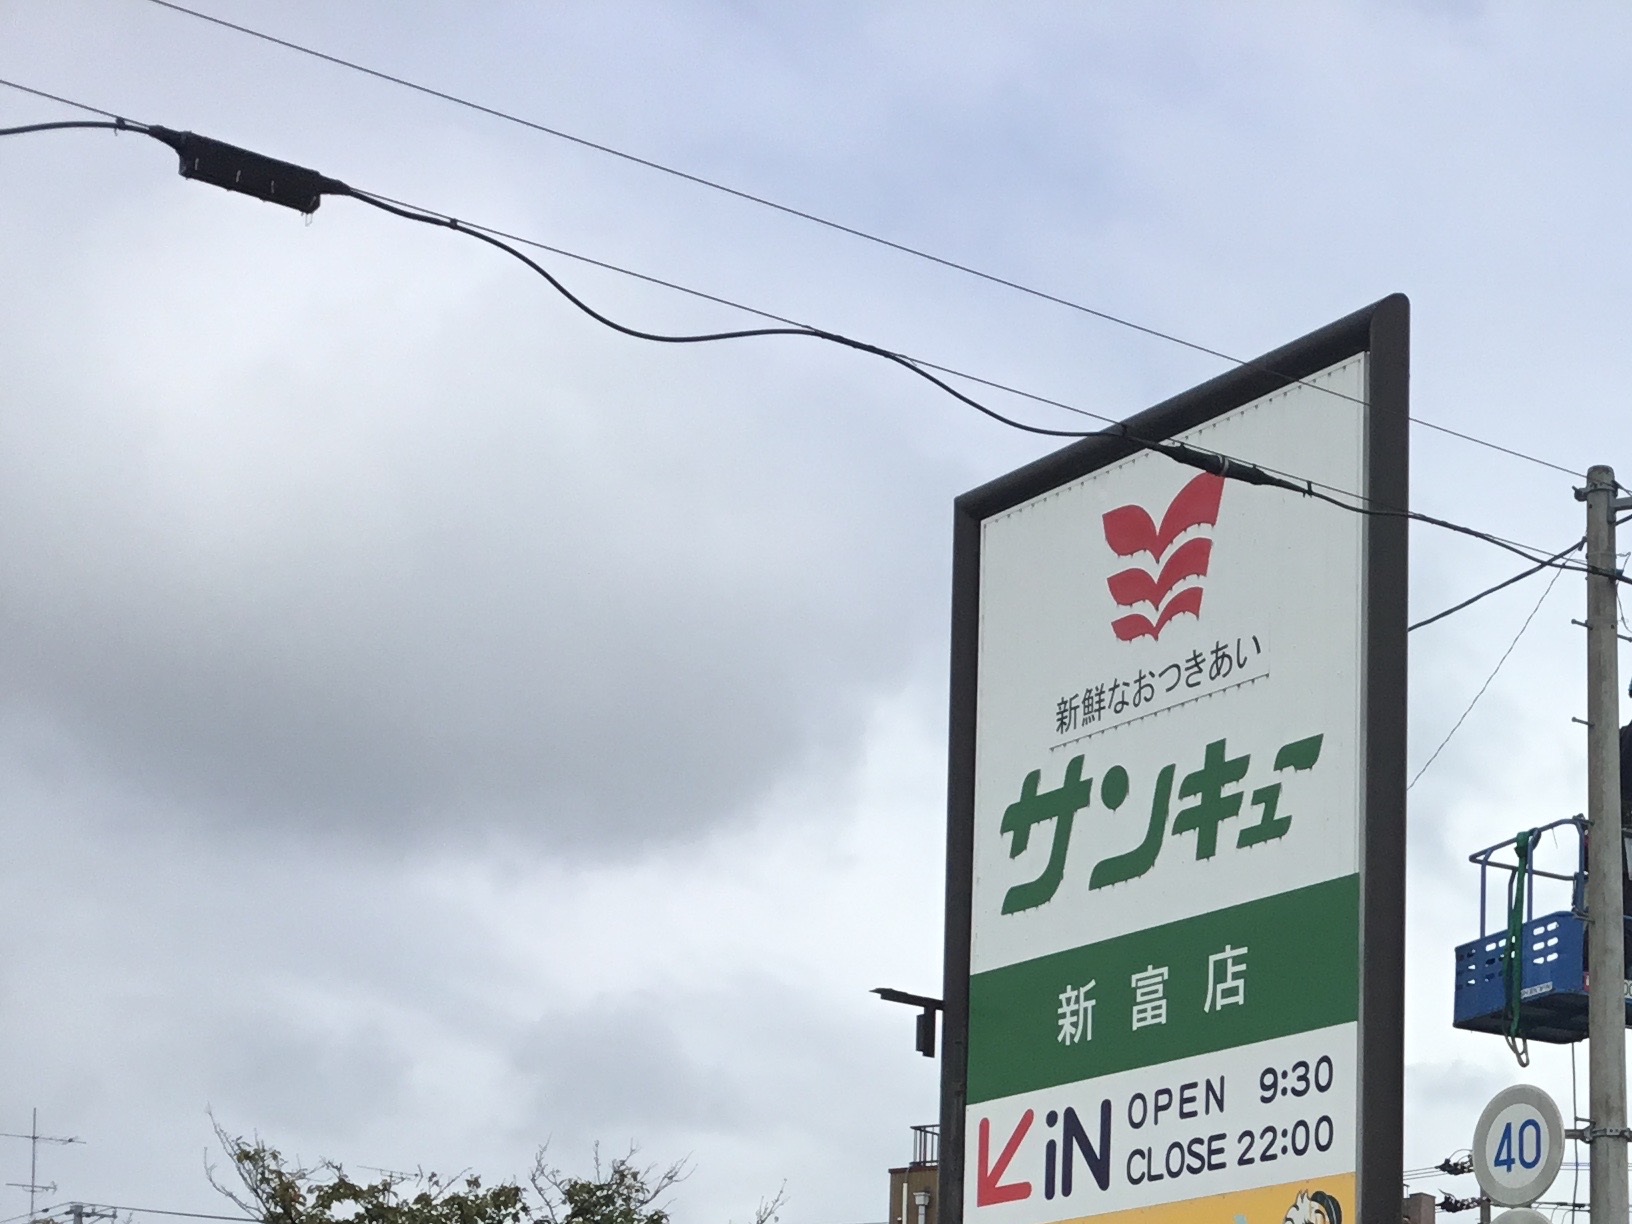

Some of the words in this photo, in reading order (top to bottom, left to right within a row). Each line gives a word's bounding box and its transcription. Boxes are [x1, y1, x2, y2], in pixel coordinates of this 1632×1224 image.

[1055, 635, 1261, 734] 新鮮なおつきあい
[1000, 733, 1324, 915] サンキュー
[1057, 945, 1248, 1046] 新富店
[1126, 1075, 1226, 1130] OPEN
[1259, 1055, 1334, 1104] 9:30
[1126, 1133, 1227, 1185] CLOSE
[1237, 1115, 1334, 1167] 22:00
[1493, 1118, 1542, 1173] 40
